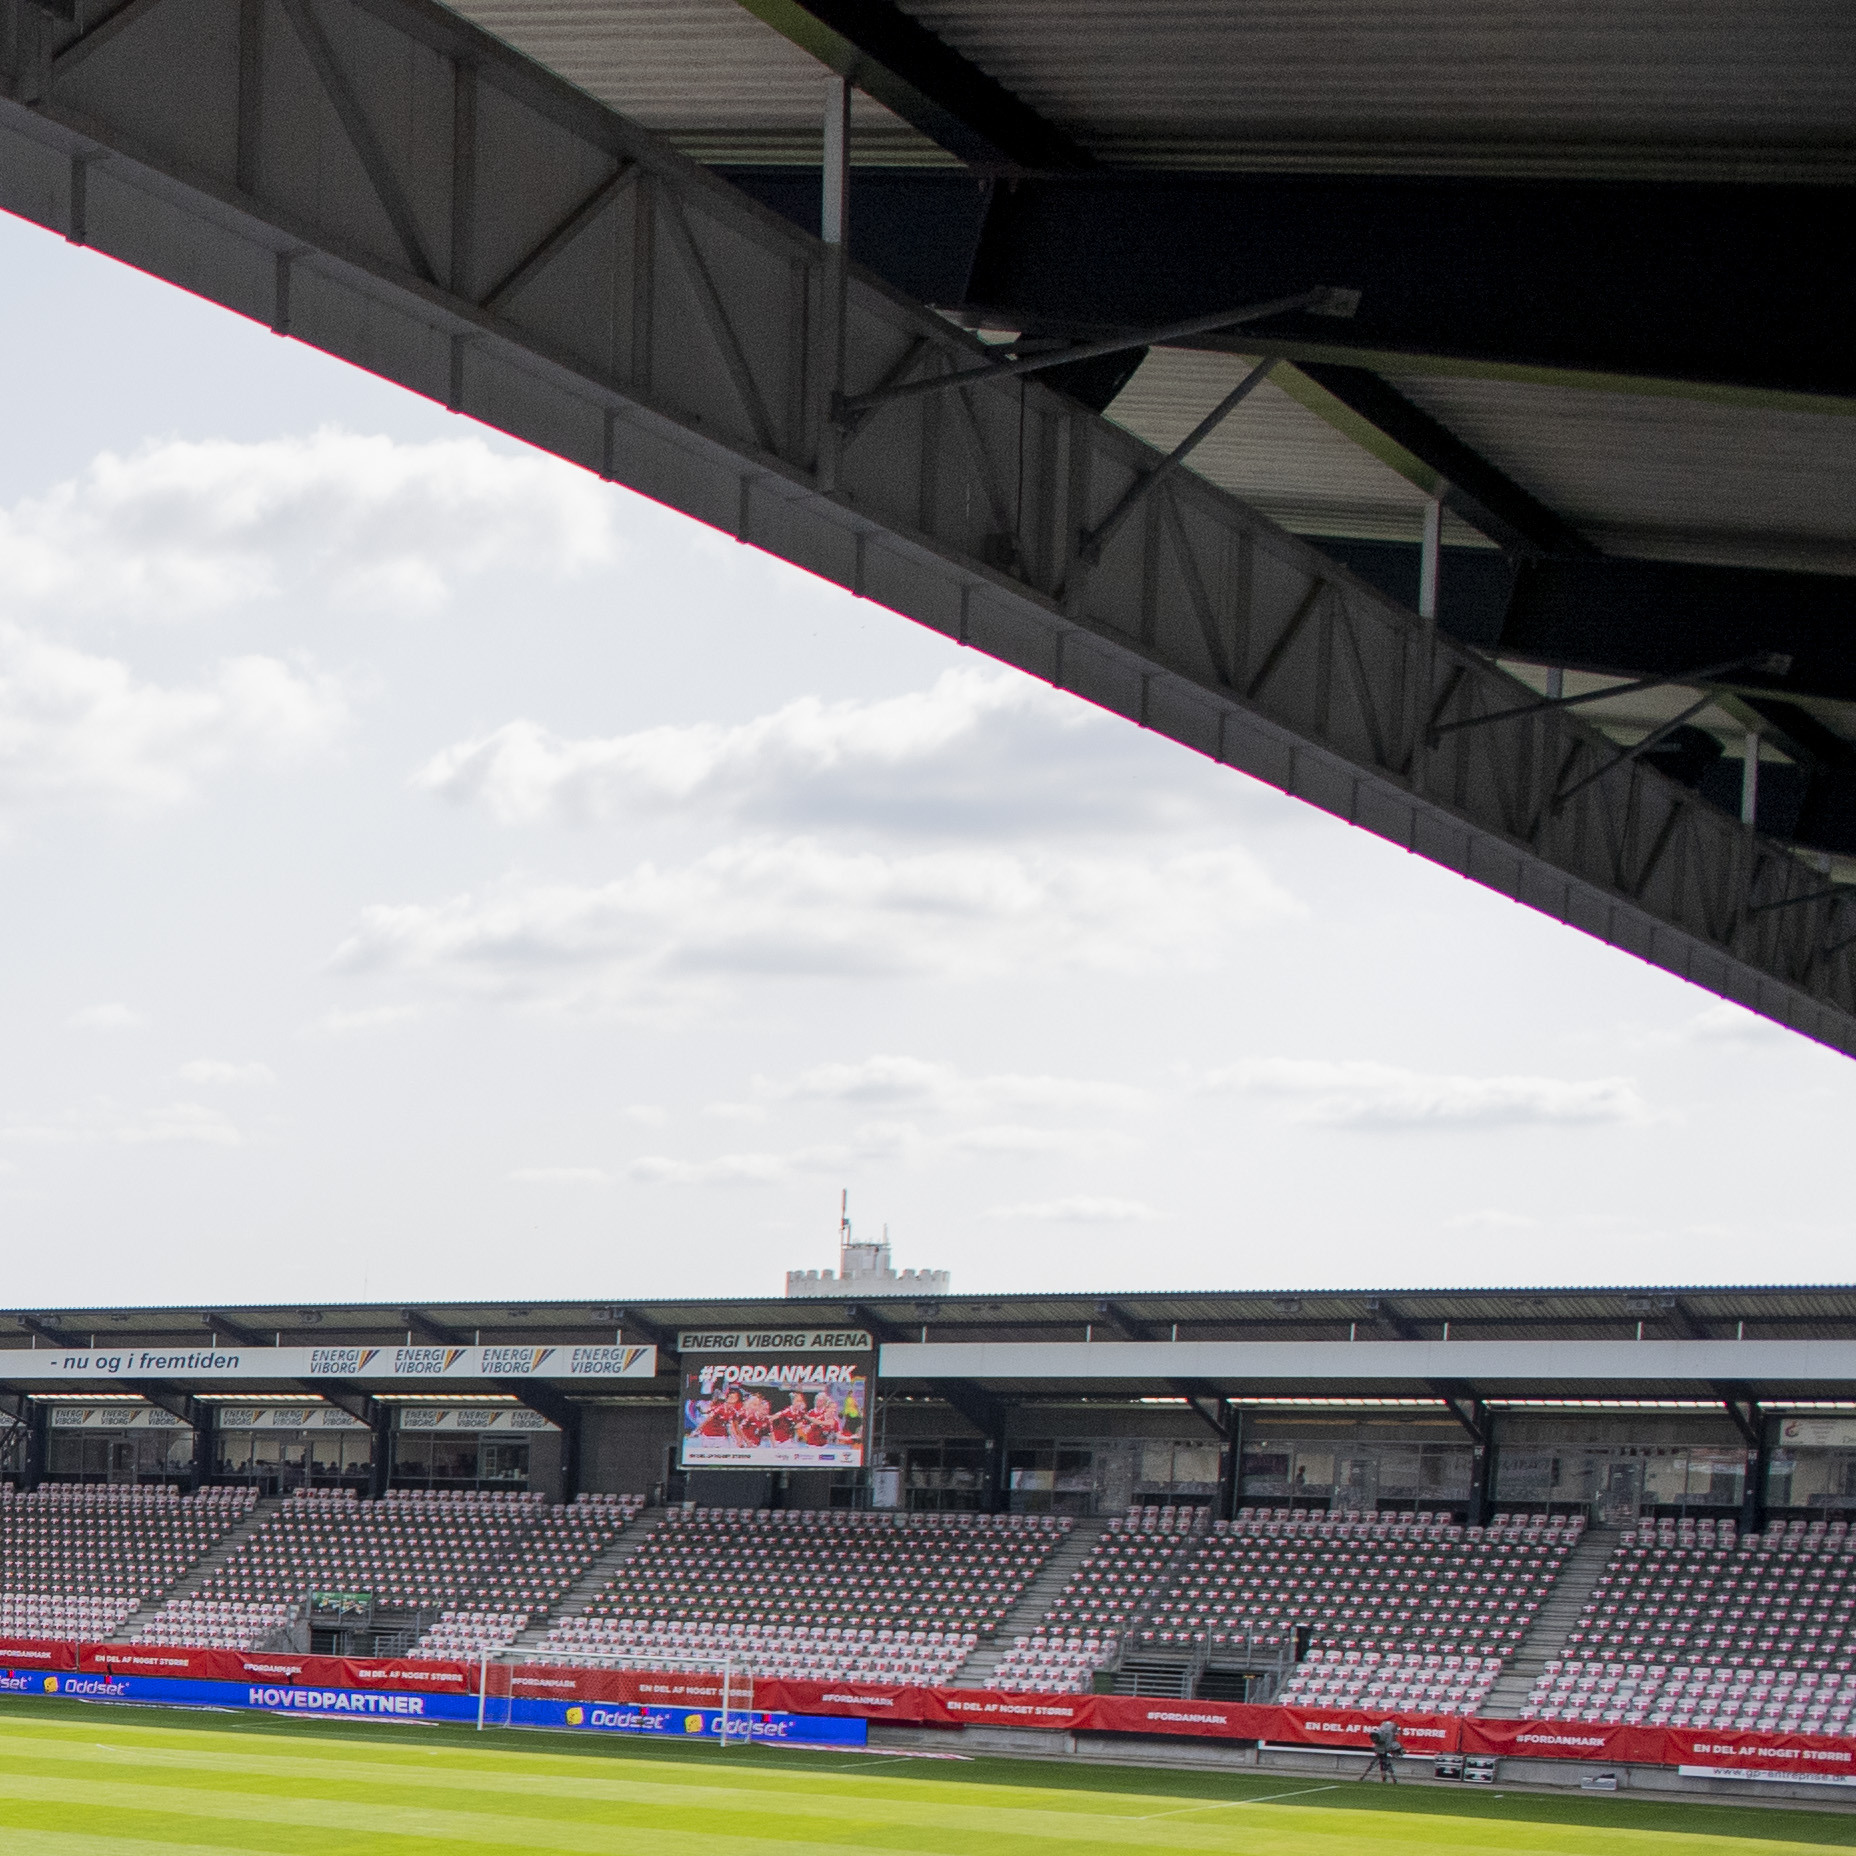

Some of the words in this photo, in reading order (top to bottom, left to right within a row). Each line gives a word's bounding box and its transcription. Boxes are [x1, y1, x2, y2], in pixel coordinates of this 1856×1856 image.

[682, 1335, 739, 1348] ENERGI
[746, 1334, 804, 1347] VIBORG
[811, 1333, 868, 1347] ARENA
[310, 1349, 359, 1362] ENERGI
[395, 1349, 446, 1362] ENERGI
[481, 1349, 532, 1362] ENERGI
[572, 1349, 623, 1362] ENERGI
[63, 1358, 87, 1369] nu
[95, 1358, 120, 1373] og
[127, 1354, 134, 1369] i
[139, 1352, 240, 1370] fremtiden
[309, 1361, 357, 1374] VIBORG
[394, 1361, 443, 1374] VIBORG
[481, 1361, 531, 1374] VIBORG
[571, 1361, 622, 1374] VIBORG
[699, 1366, 858, 1384] #FORDANMARK
[65, 1678, 125, 1695] Oddset
[249, 1687, 424, 1714] HOVEDPARTNER
[822, 1694, 893, 1706] #FORDANMARK
[947, 1702, 961, 1711] EN
[963, 1703, 983, 1712] DEL
[984, 1704, 999, 1713] AF
[1000, 1705, 1034, 1714] NOGET
[1035, 1706, 1073, 1716] STØRRE
[591, 1709, 665, 1729] Oddset
[1147, 1711, 1227, 1724] #FORDANMARK
[1305, 1722, 1320, 1731] EN
[1323, 1723, 1345, 1733] DEL
[1346, 1724, 1363, 1734] AF
[1404, 1727, 1446, 1738] STØRRE
[1516, 1734, 1605, 1747] #FORDANMARK
[1694, 1744, 1711, 1754] EN
[1714, 1745, 1738, 1755] DEL
[1740, 1746, 1759, 1756] AF
[1760, 1747, 1802, 1759] NOGET
[1804, 1750, 1851, 1762] STØRRE
